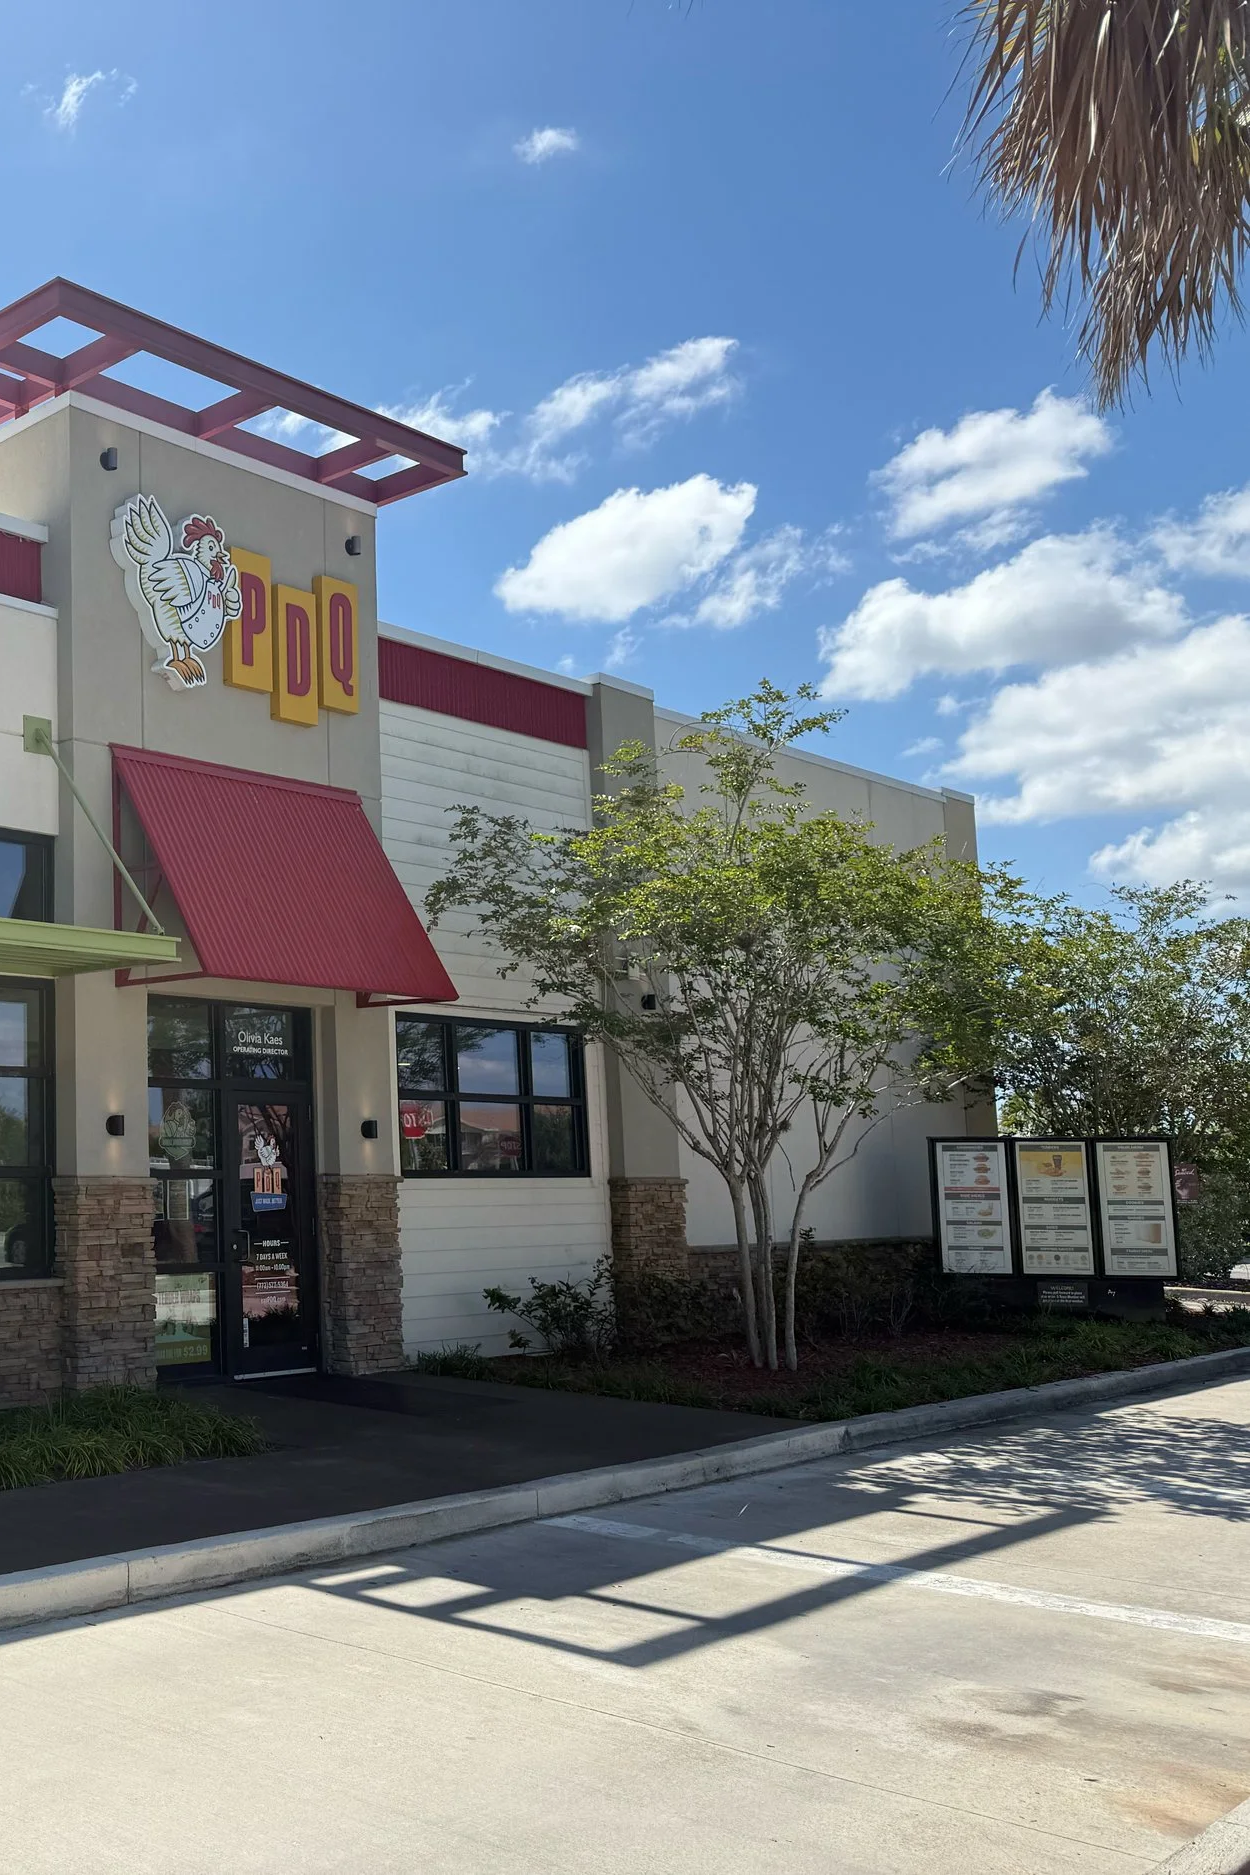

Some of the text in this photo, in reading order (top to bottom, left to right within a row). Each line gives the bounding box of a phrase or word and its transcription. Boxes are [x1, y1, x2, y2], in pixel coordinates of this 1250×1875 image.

[207, 590, 221, 610] PDQ
[240, 571, 354, 698] PDQ
[238, 1030, 283, 1045] Olivia Kaes
[256, 1171, 280, 1192] PDQ
[262, 1239, 281, 1247] HOURS
[275, 1252, 288, 1260] WEEK
